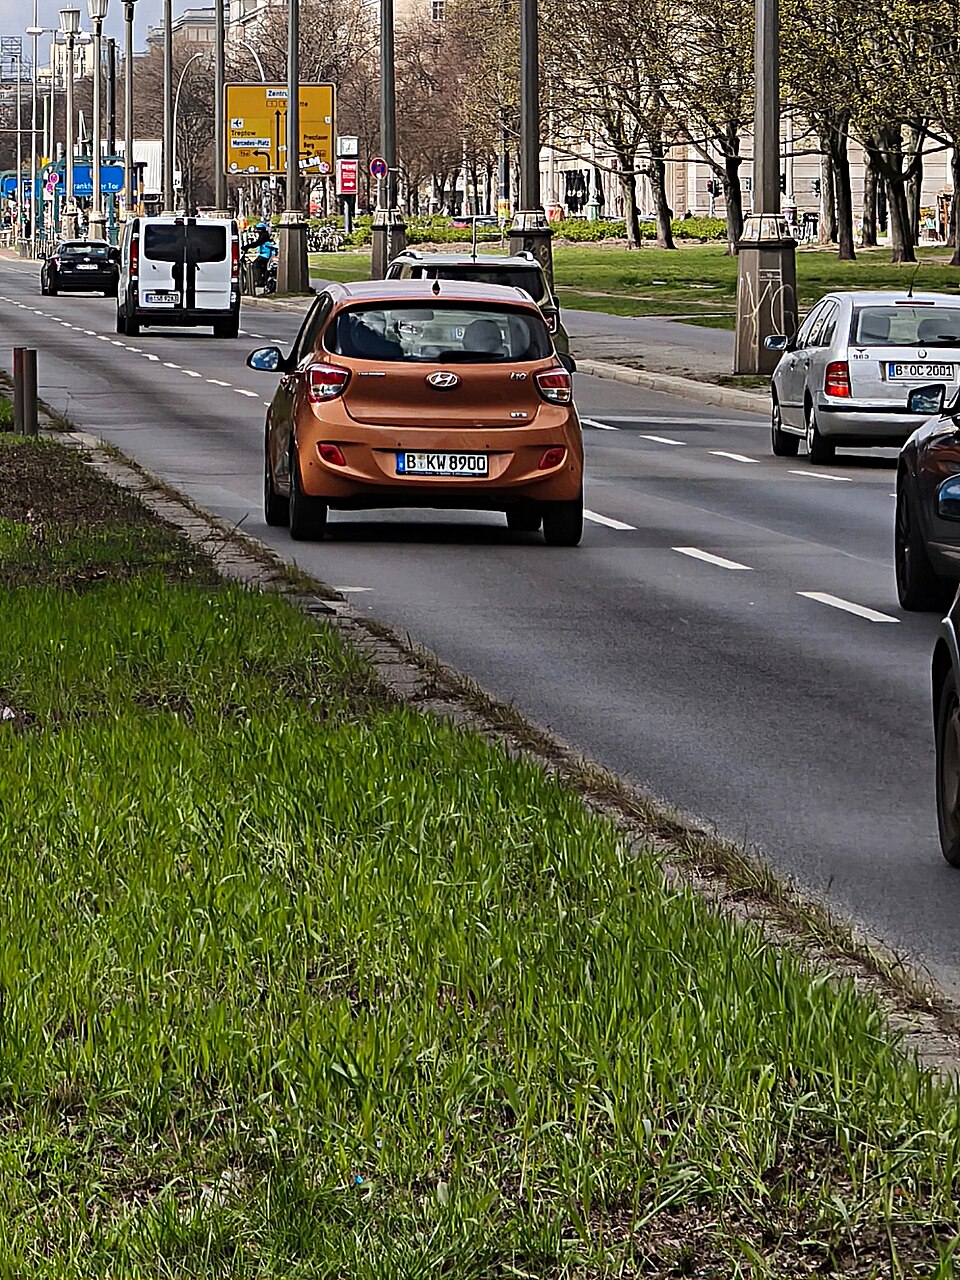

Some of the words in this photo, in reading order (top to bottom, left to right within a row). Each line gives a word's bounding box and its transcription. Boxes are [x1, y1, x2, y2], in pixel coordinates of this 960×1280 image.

[108, 182, 119, 190] Tor
[895, 365, 903, 376] B
[909, 365, 924, 376] OC
[926, 365, 952, 377] 2001
[406, 454, 416, 469] B
[426, 455, 447, 471] KW
[449, 456, 486, 471] 8900
